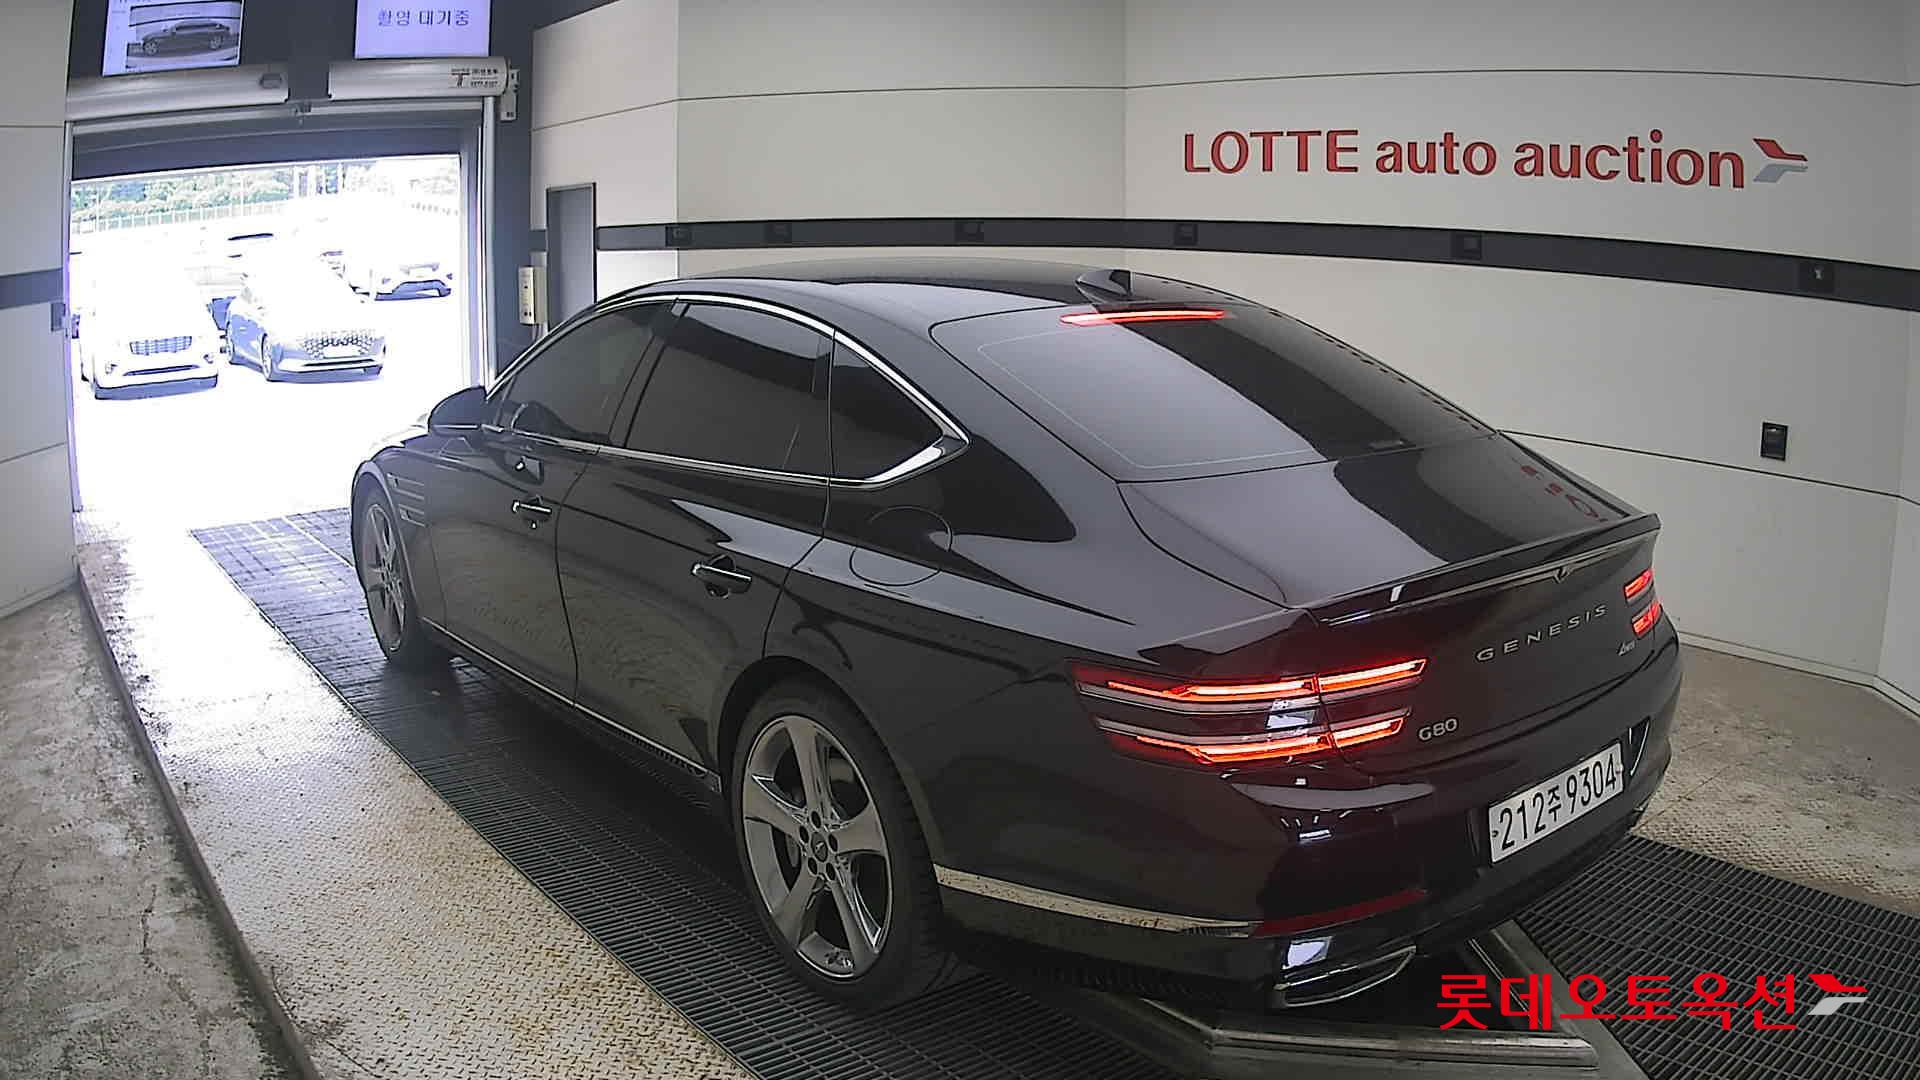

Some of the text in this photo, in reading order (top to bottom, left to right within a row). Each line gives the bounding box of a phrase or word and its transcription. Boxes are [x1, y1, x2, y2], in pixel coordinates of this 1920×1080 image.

[1184, 129, 1745, 189] LOTTE auto auction
[1475, 604, 1608, 662] GENESIS
[1418, 717, 1459, 742] G80
